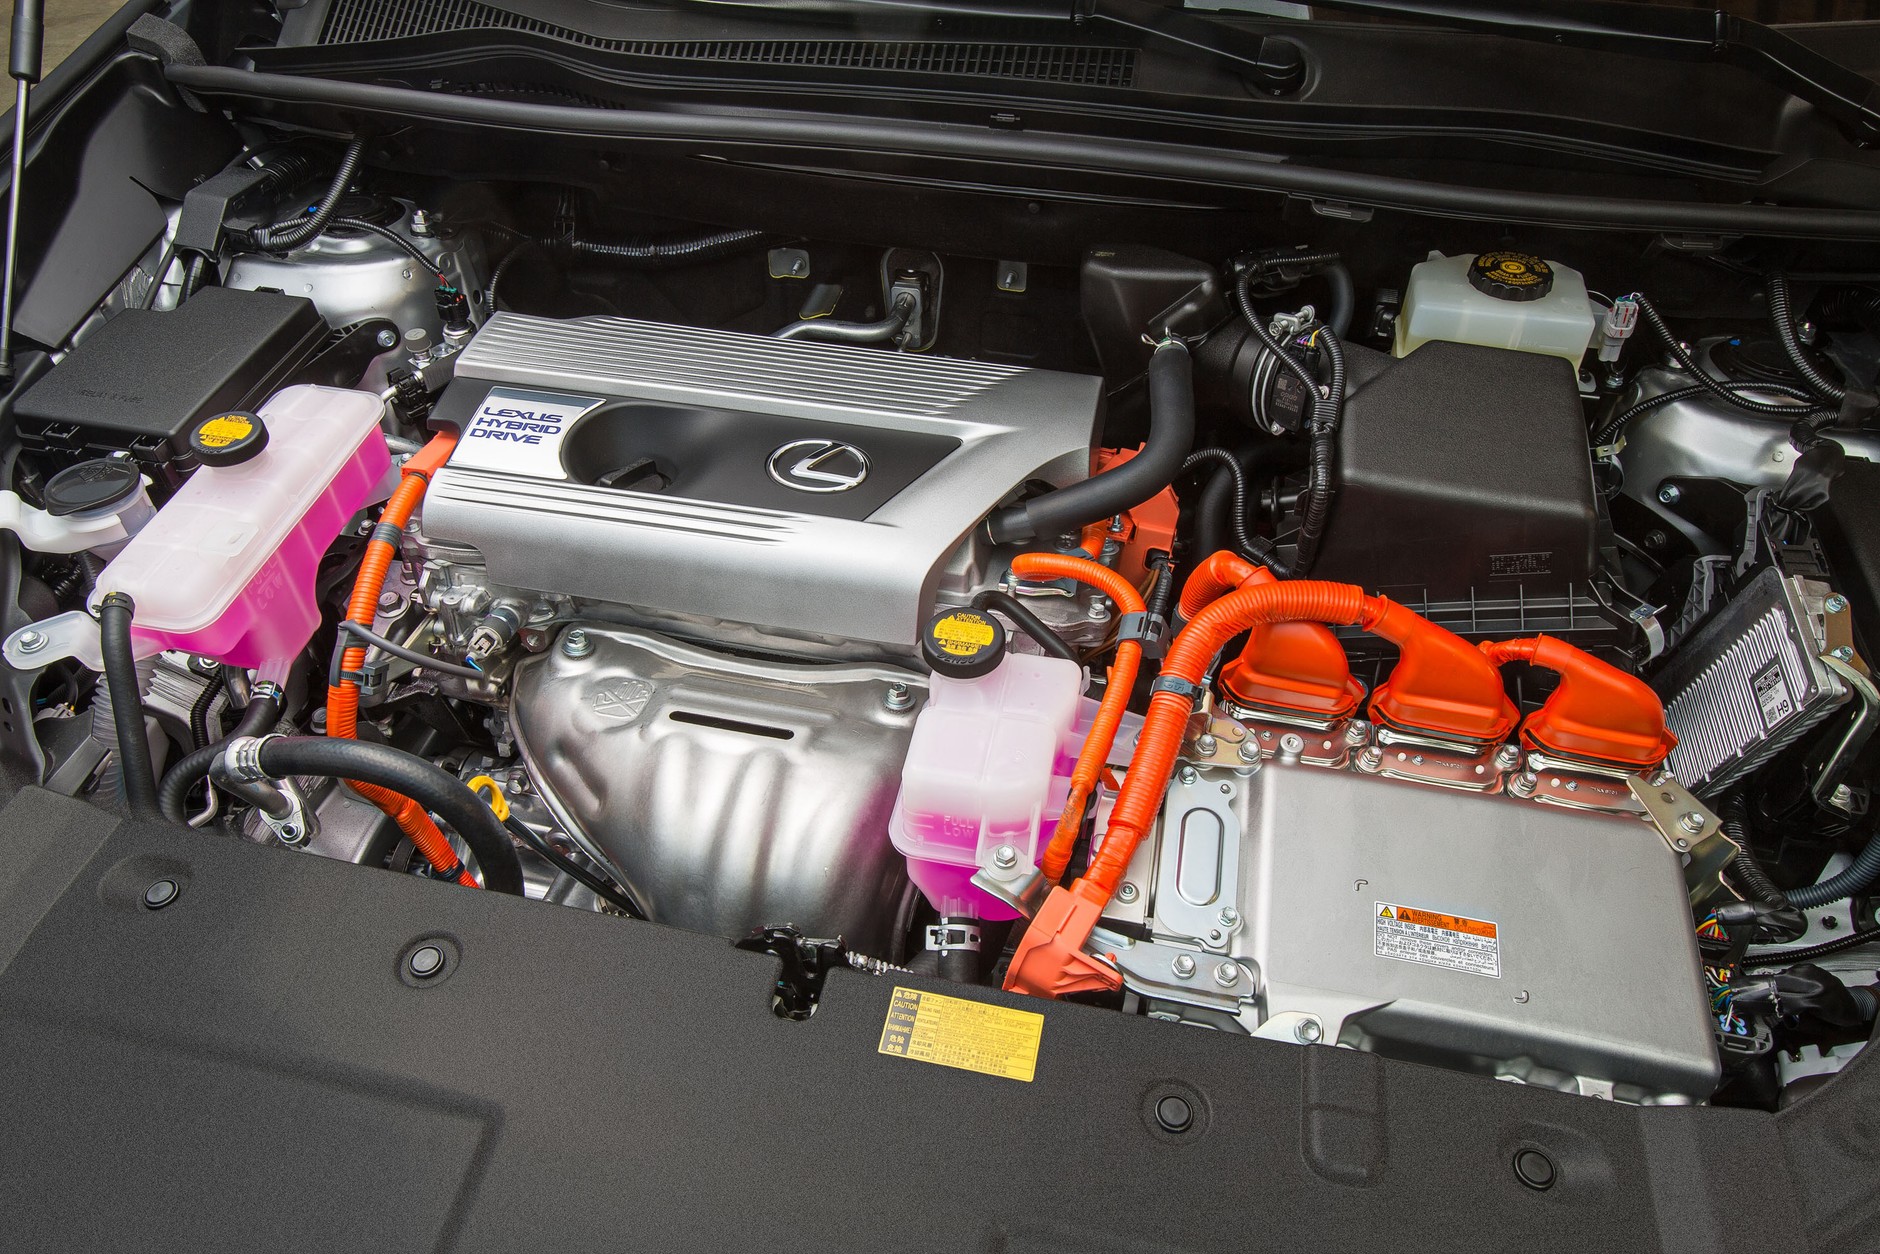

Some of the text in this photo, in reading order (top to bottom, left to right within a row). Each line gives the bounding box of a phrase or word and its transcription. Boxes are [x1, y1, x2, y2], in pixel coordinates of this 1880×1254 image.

[483, 406, 563, 424] LEXUS
[475, 417, 562, 435] HYBRID
[469, 427, 543, 445] DRIVE
[957, 612, 981, 620] CAUTION
[937, 653, 975, 664] DENSO
[1776, 699, 1790, 717] H9
[944, 815, 975, 829] FULL
[944, 825, 975, 838] LOW
[1412, 910, 1441, 920] WARNING
[893, 999, 918, 1010] CAUTION
[890, 1011, 914, 1022] ATTENTION
